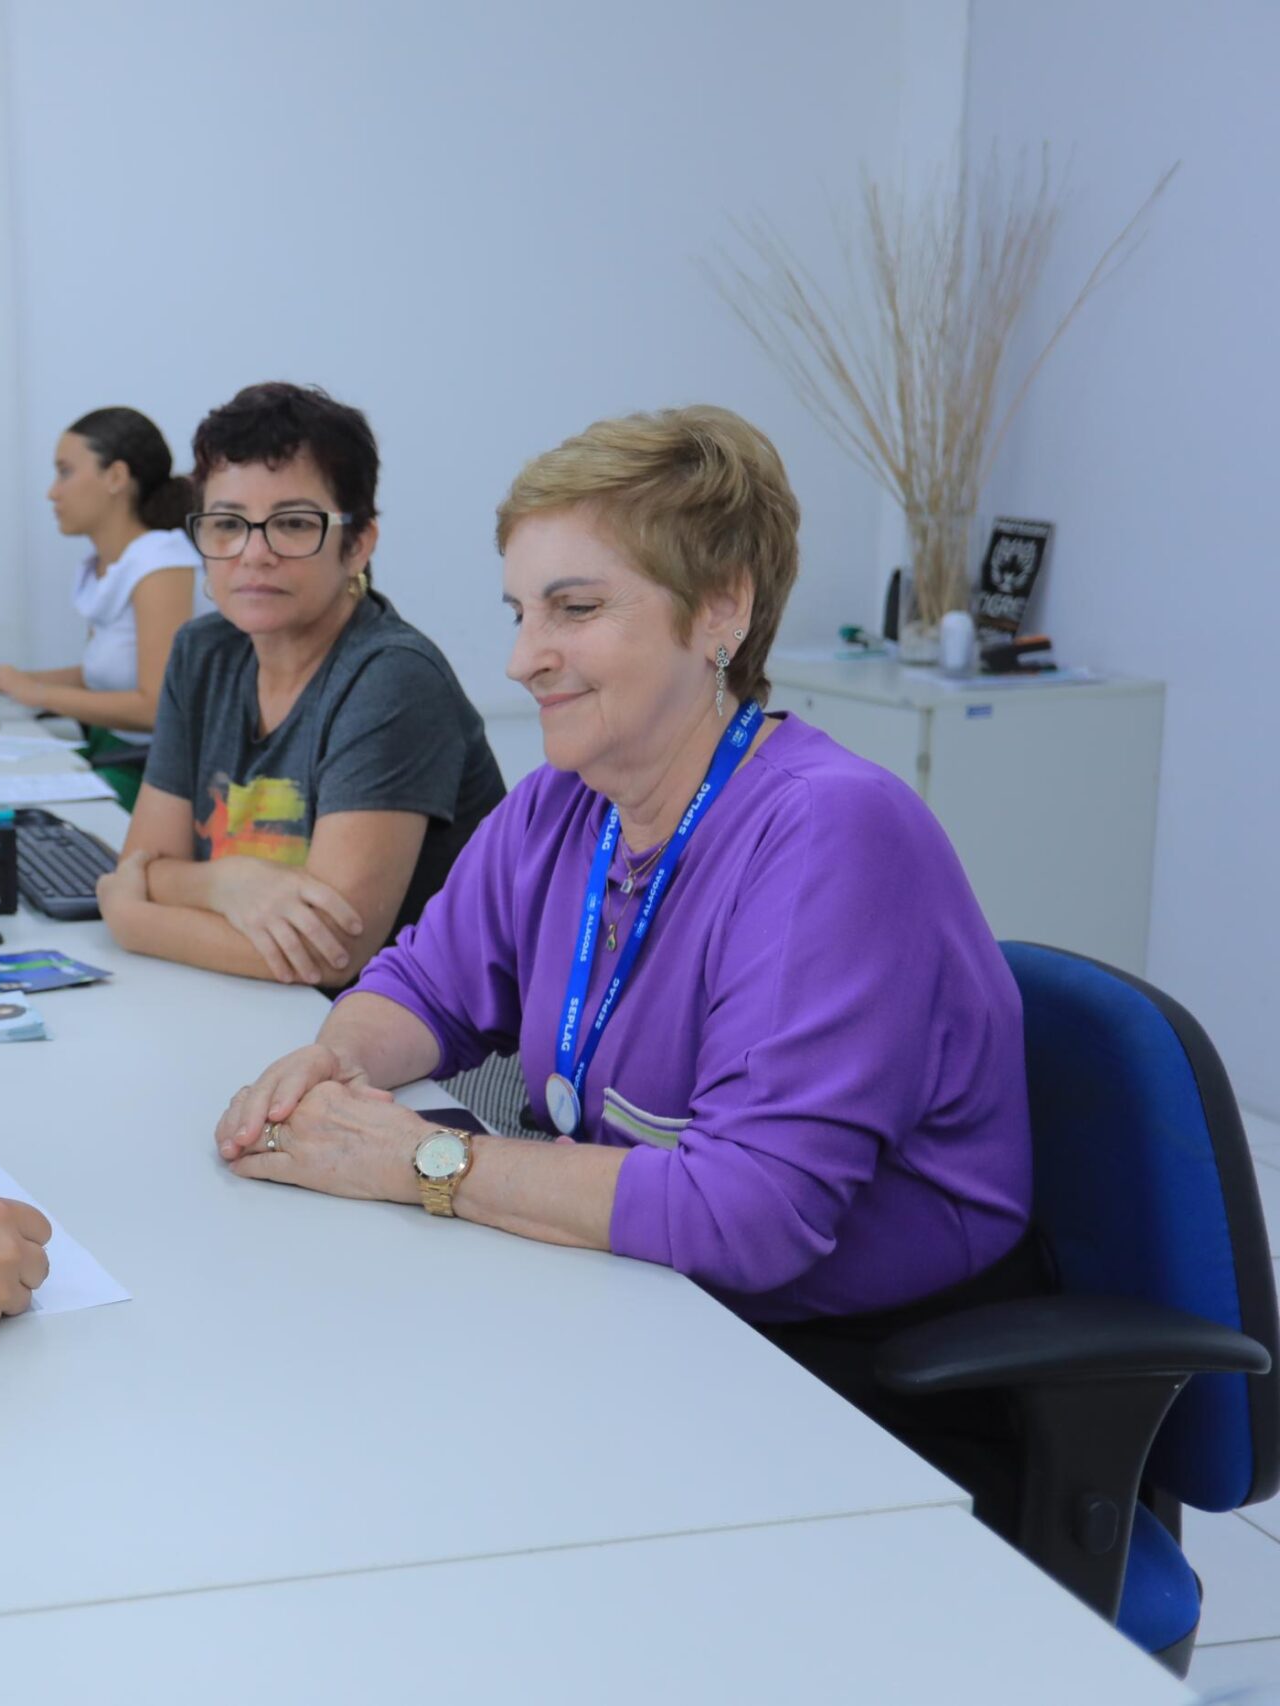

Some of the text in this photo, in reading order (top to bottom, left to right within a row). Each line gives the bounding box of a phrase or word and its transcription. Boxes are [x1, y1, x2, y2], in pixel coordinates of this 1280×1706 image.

[678, 783, 711, 837] SEPLAG
[642, 868, 666, 918] ALAGOAS
[578, 913, 593, 963] ALAGOAS
[560, 997, 580, 1052] SEPLAG
[594, 977, 621, 1031] SEPLAG
